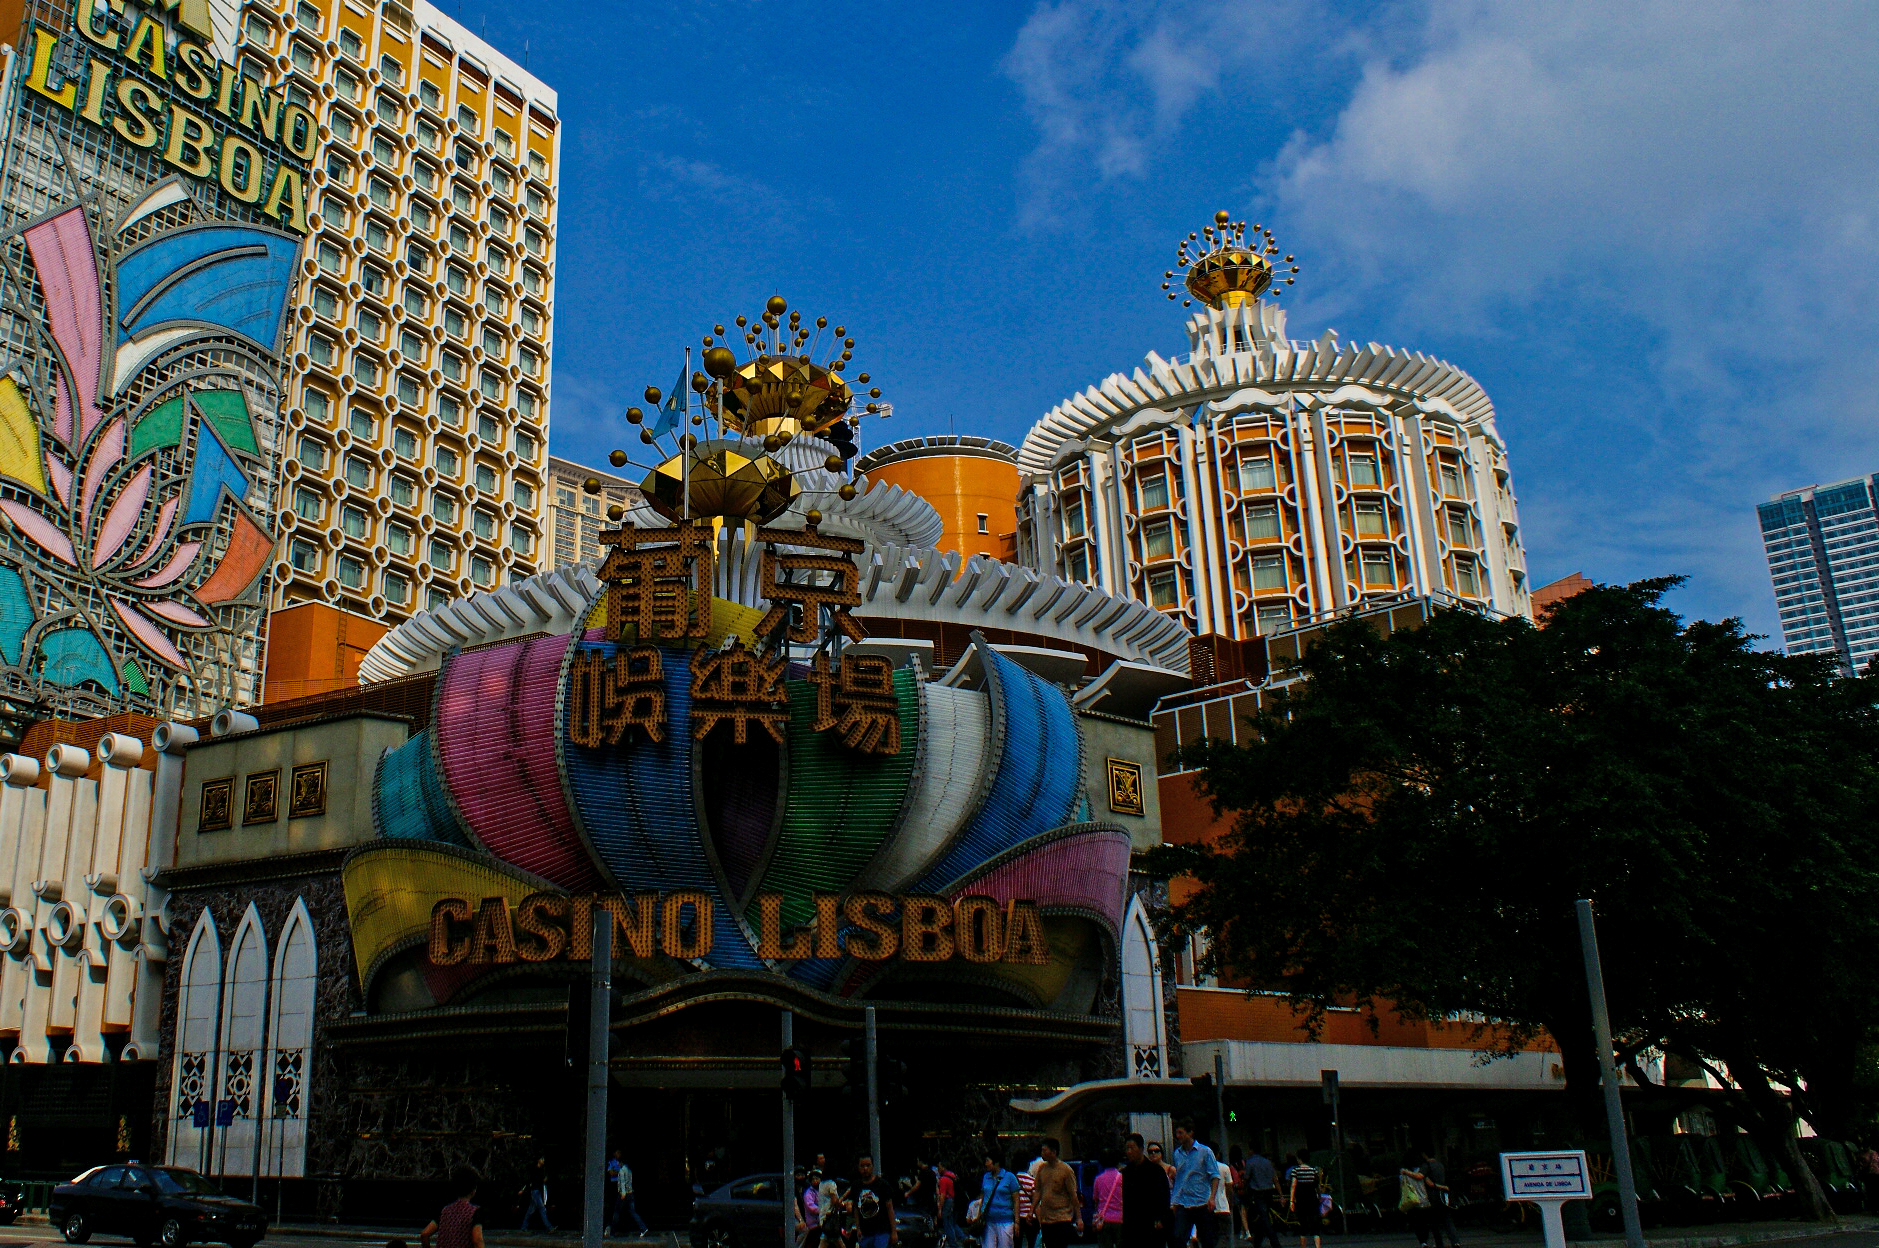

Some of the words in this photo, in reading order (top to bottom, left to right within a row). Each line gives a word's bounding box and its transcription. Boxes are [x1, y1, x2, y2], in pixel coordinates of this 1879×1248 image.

[23, 26, 309, 236] LISBOA
[73, 0, 319, 162] CASINO
[598, 519, 869, 643] 葡京
[428, 887, 715, 966] CASINO
[756, 889, 1051, 966] LISBOA
